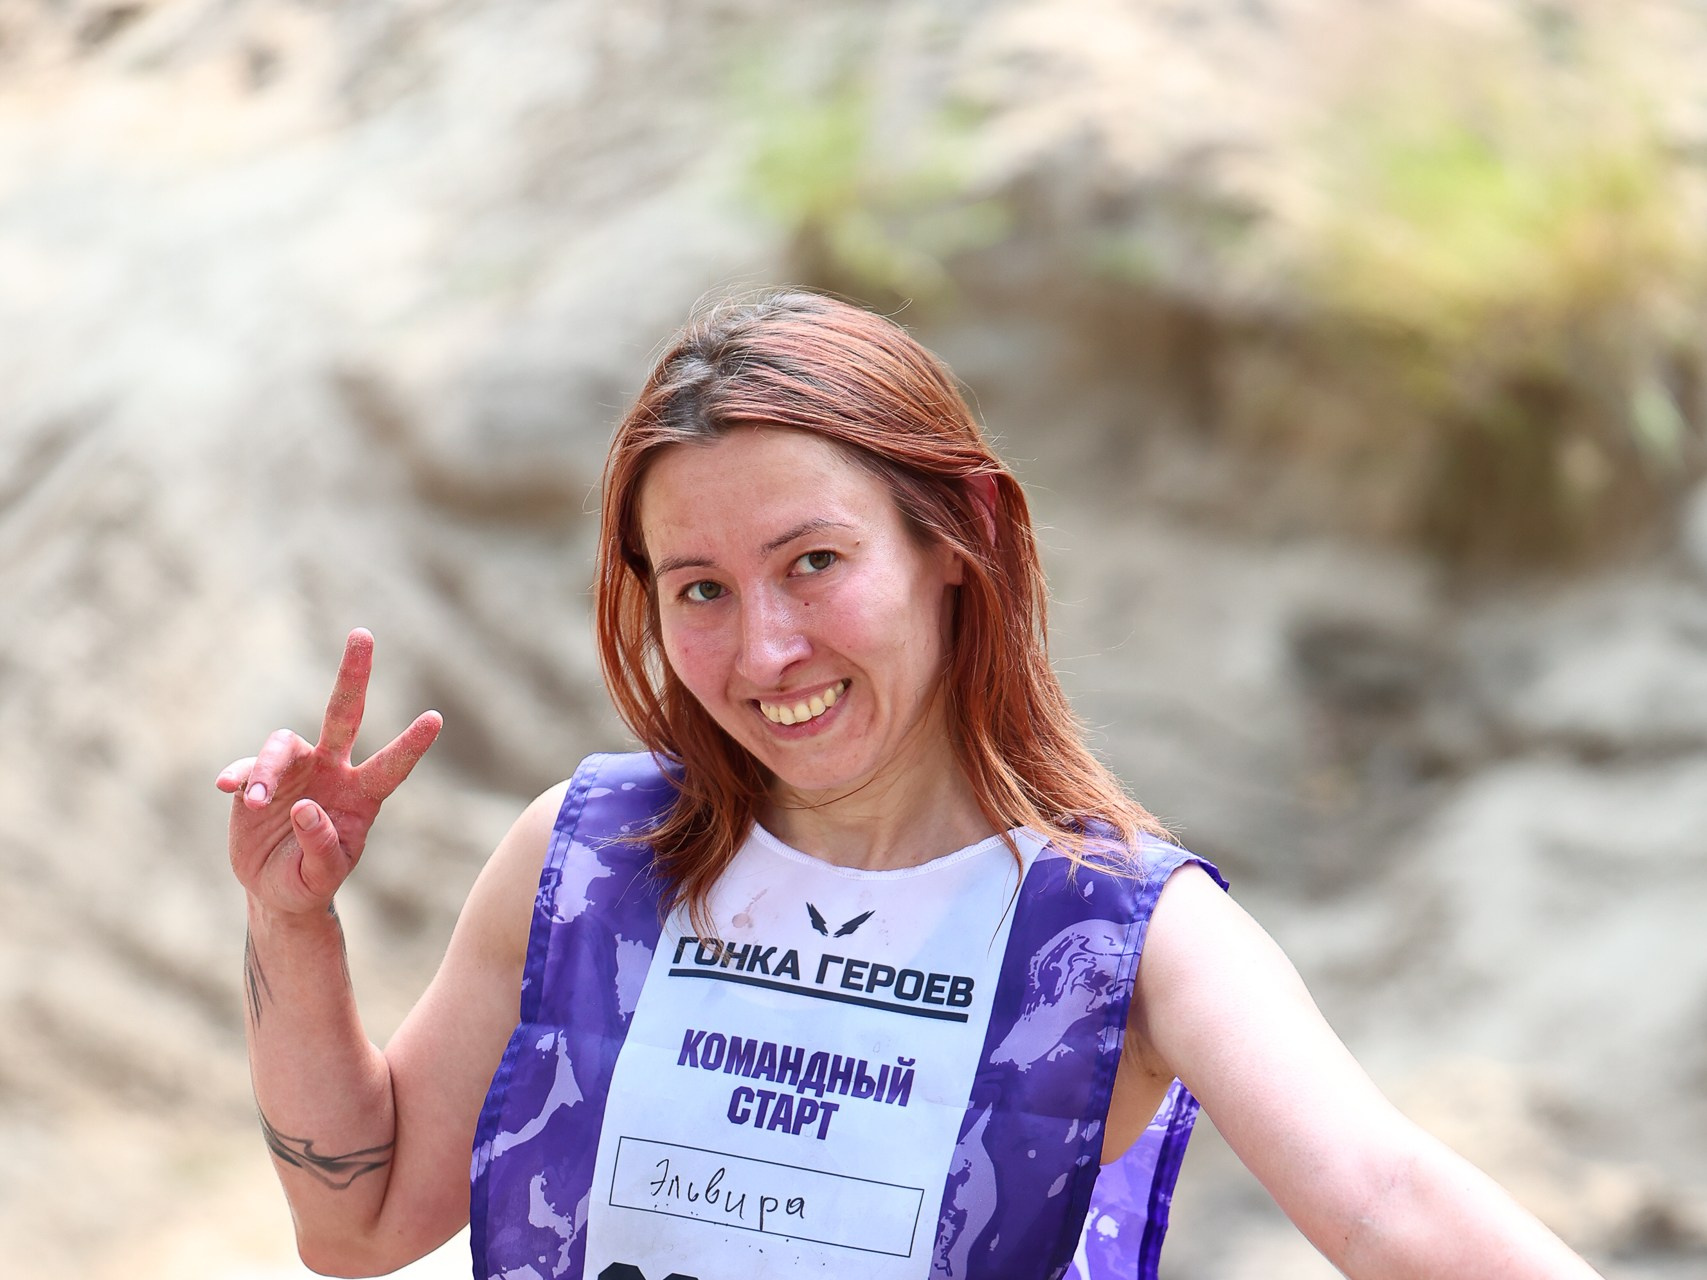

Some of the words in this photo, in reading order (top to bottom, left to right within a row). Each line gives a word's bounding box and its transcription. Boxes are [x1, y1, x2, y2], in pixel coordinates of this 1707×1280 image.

[672, 936, 801, 981] ГОНКА
[815, 953, 975, 1008] ГЕРОЕВ
[677, 1028, 916, 1107] КОМАНДНЫЙ
[726, 1085, 840, 1141] СТАРТ
[650, 1158, 805, 1232] Эльвира
